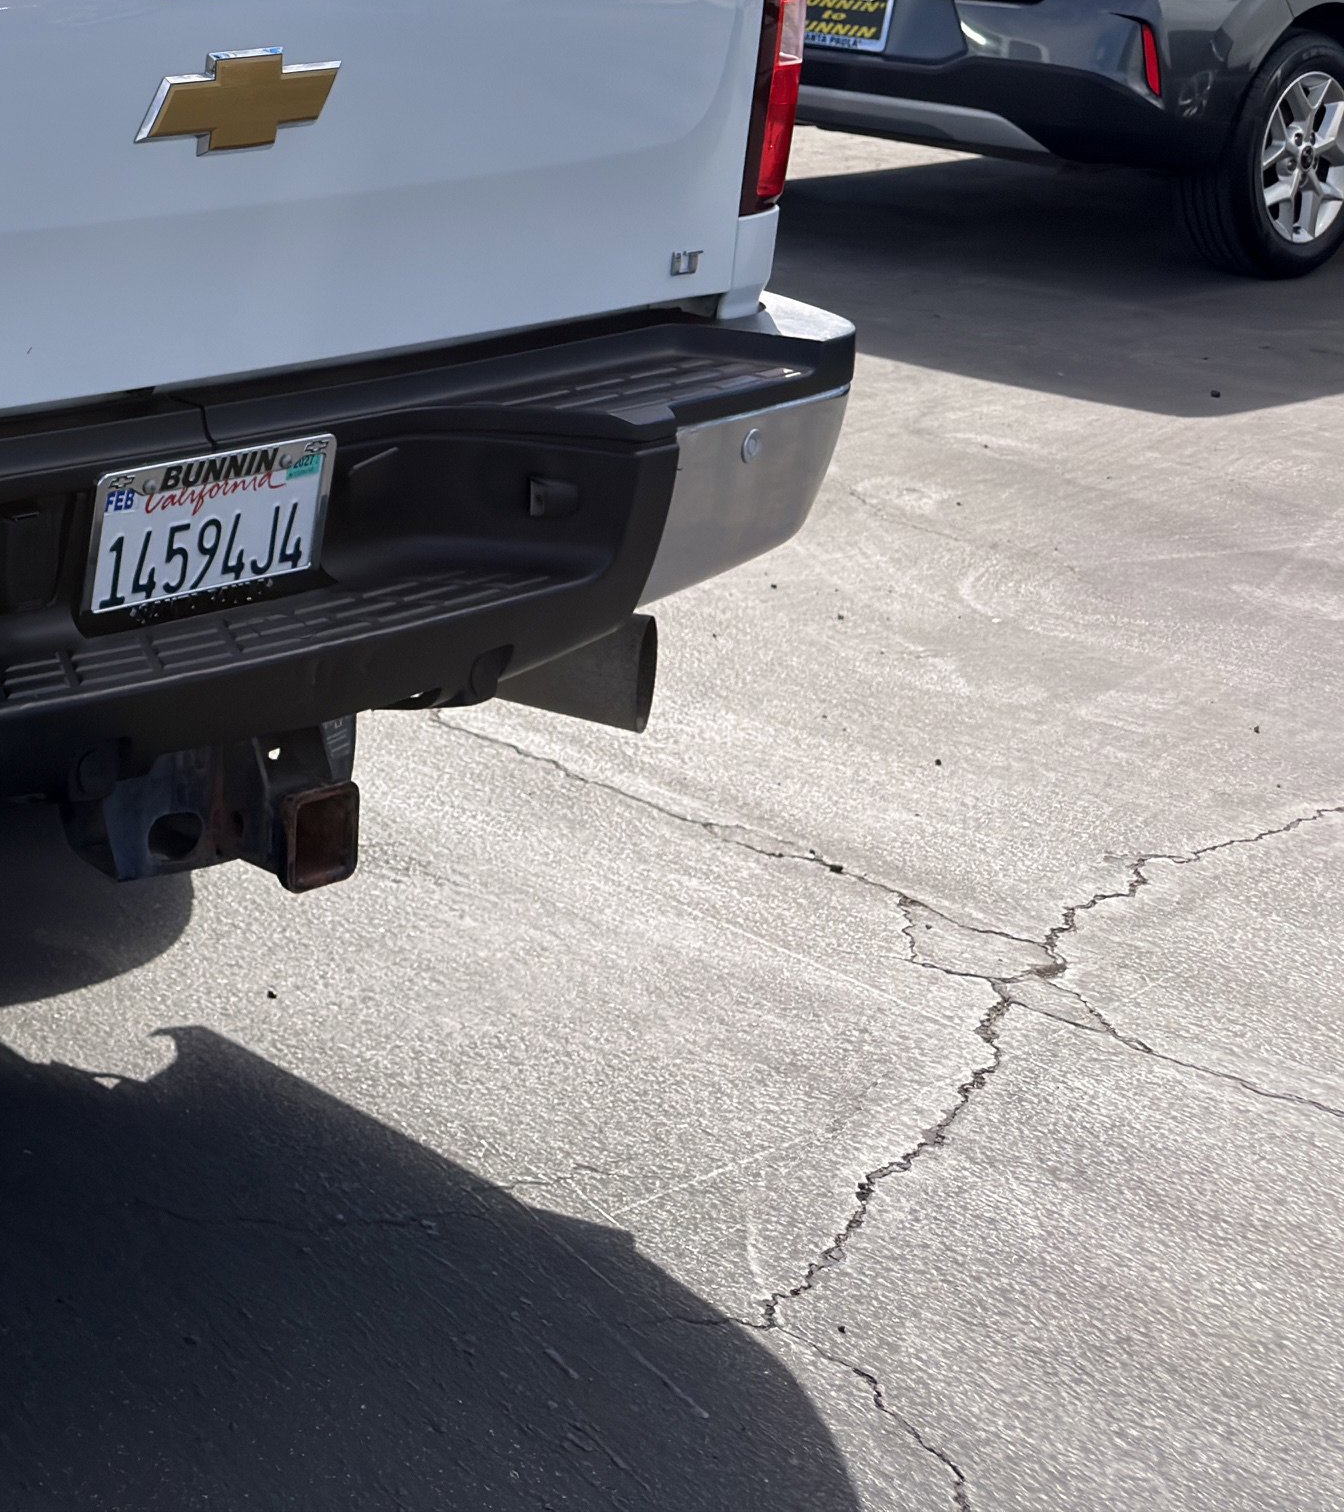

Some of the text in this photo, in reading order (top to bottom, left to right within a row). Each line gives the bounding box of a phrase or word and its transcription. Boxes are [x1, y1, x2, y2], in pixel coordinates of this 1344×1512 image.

[822, 9, 847, 21] to
[670, 249, 705, 277] LT
[159, 447, 280, 492] BUNNIN
[104, 490, 135, 513] FEB
[144, 472, 287, 516] California
[99, 501, 302, 610] 14594J4
